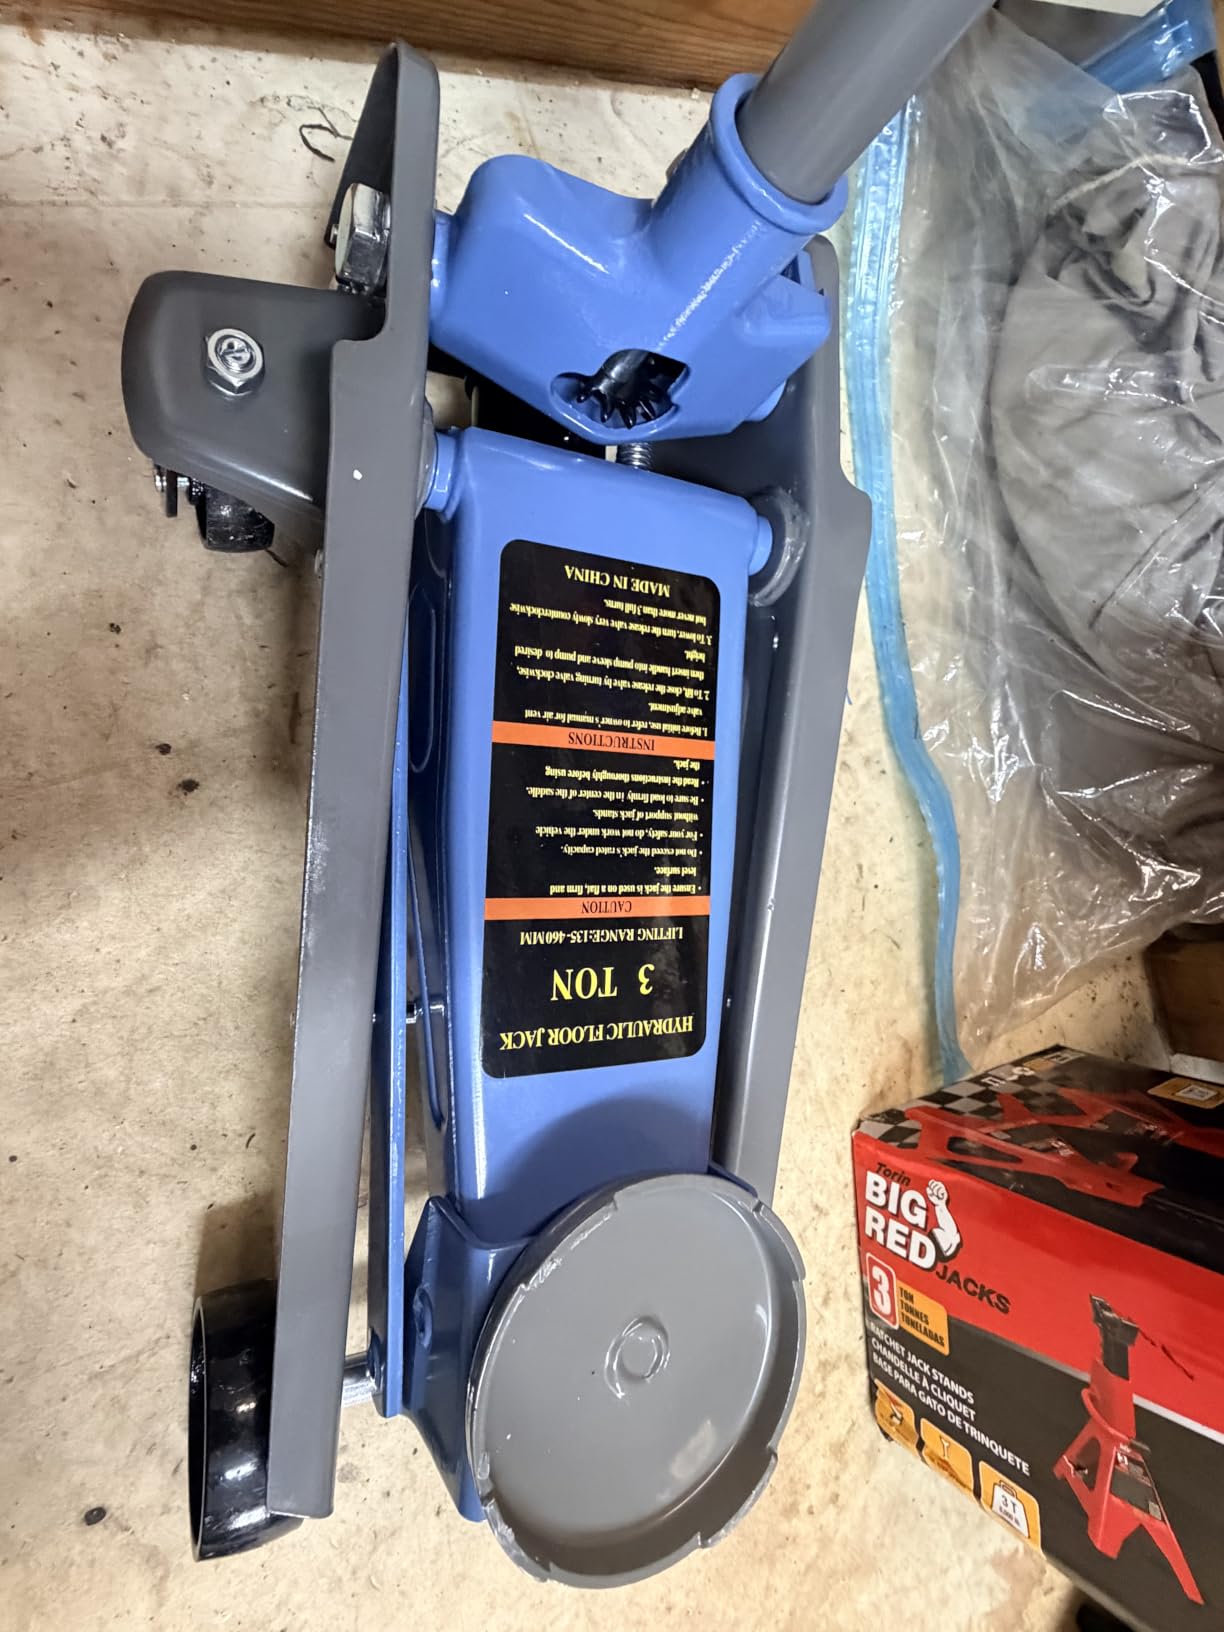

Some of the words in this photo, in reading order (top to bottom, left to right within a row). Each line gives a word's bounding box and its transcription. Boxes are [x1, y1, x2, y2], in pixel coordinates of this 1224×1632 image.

[564, 565, 610, 586] CHINA
[613, 575, 628, 590] IN
[631, 578, 671, 598] MADE
[509, 603, 571, 620] counterclockwise
[624, 603, 636, 614] full
[637, 604, 642, 615] 3
[642, 606, 658, 619] than
[659, 607, 676, 620] more
[572, 611, 594, 626] slowly
[594, 614, 609, 626] very
[676, 611, 695, 623] never
[695, 615, 707, 627] but
[610, 620, 627, 631] valve
[628, 622, 650, 635] release
[651, 626, 661, 638] the
[662, 628, 677, 639] turn
[697, 633, 706, 645] To
[514, 645, 543, 660] desired
[545, 650, 553, 660] to
[554, 648, 577, 662] pump
[577, 654, 592, 665] and
[592, 656, 612, 669] sleeve
[613, 656, 634, 670] pump
[634, 663, 648, 674] into
[649, 664, 671, 677] handle
[671, 667, 690, 679] insert
[555, 672, 574, 684] valve
[575, 672, 602, 686] turning
[690, 670, 704, 681] then
[603, 675, 612, 689] by
[613, 679, 631, 690] valve
[631, 681, 654, 693] release
[655, 684, 666, 695] the
[666, 686, 682, 697] close
[694, 689, 703, 700] To
[524, 709, 541, 719] vent
[648, 702, 686, 715] adjustment.
[686, 707, 703, 718] valve
[542, 711, 554, 723] air
[554, 712, 566, 723] for
[567, 713, 594, 723] manual
[623, 719, 630, 728] to
[631, 720, 648, 730] refer
[662, 723, 681, 734] initial
[681, 725, 702, 736] Before
[569, 732, 655, 751] INSTRUCTIONS
[673, 759, 690, 770] jack.
[689, 761, 700, 771] the
[545, 765, 566, 779] using
[567, 770, 591, 781] before
[592, 769, 630, 783] thoroughly
[631, 774, 671, 786] instructions
[672, 777, 683, 786] the
[683, 778, 699, 788] Read
[525, 787, 554, 798] saddle.
[555, 788, 568, 799] the
[568, 789, 577, 799] of
[577, 790, 602, 799] center
[603, 791, 615, 801] the
[616, 792, 624, 802] in
[626, 790, 649, 804] firmly
[650, 794, 665, 804] load
[666, 794, 673, 804] to
[674, 795, 689, 803] sure
[689, 796, 699, 806] Be
[619, 809, 636, 821] jack
[636, 811, 644, 821] of
[645, 810, 672, 820] support
[673, 812, 698, 823] without
[535, 826, 562, 837] vehicle
[563, 827, 576, 838] the
[577, 827, 600, 838] under
[601, 828, 621, 839] work
[622, 829, 634, 839] not
[635, 829, 645, 839] do
[668, 829, 685, 838] your
[686, 831, 697, 841] For
[560, 844, 594, 856] capacity.
[595, 847, 615, 856] rated
[638, 848, 651, 857] the
[651, 848, 674, 857] exceed
[675, 848, 686, 856] not
[687, 849, 697, 858] Do
[654, 867, 681, 877] surface.
[682, 867, 696, 877] level
[549, 885, 565, 895] and
[566, 885, 583, 896] firm
[601, 885, 606, 893] a
[607, 885, 617, 893] on
[618, 885, 635, 895] used
[637, 885, 643, 895] is
[644, 882, 660, 895] jack
[660, 885, 671, 894] the
[672, 885, 696, 894] Ensure
[581, 901, 632, 913] CAUTION
[637, 927, 683, 941] LIFTING
[550, 967, 618, 1001] TON
[638, 964, 655, 995] 3
[607, 1016, 693, 1040] HYDRAULIC
[499, 1026, 545, 1050] JACK
[547, 1024, 604, 1046] FLOOR
[876, 1162, 911, 1186] Torin
[865, 1171, 927, 1228] BIG
[865, 1206, 936, 1269] RED
[872, 1266, 891, 1315] 3
[900, 1287, 914, 1302] TON
[936, 1265, 1011, 1314] JACKS
[901, 1301, 929, 1325] TONNES
[901, 1312, 944, 1347] TONELADAS
[870, 1323, 905, 1355] RATCHET
[907, 1350, 930, 1375] JACK
[932, 1370, 974, 1404] STANDS
[871, 1337, 920, 1382] CHANDELLE
[931, 1382, 976, 1421] CLIQUET
[872, 1352, 893, 1377] BASE
[894, 1372, 917, 1398] PARA
[918, 1391, 946, 1416] GATO
[947, 1411, 963, 1429] DE
[963, 1422, 1030, 1476] TRINQUETE
[1000, 1494, 1008, 1507] 3
